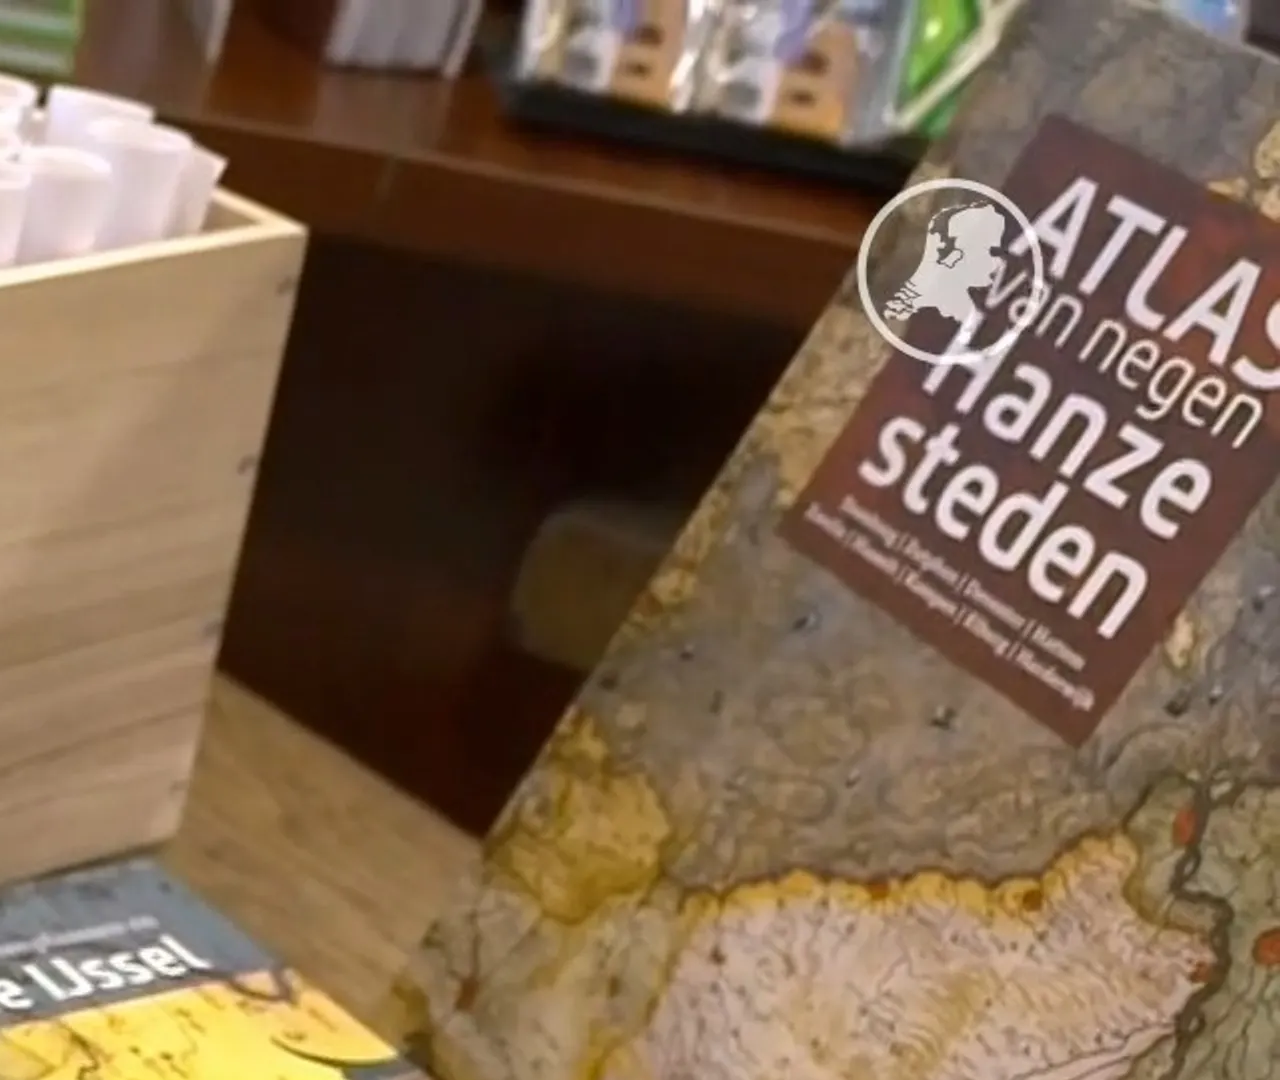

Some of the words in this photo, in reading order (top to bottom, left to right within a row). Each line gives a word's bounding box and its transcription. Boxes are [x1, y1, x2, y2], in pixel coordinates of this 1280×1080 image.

[922, 308, 1212, 540] Hanze
[985, 257, 1083, 348] van
[1078, 318, 1263, 449] negen
[858, 416, 1148, 640] steden
